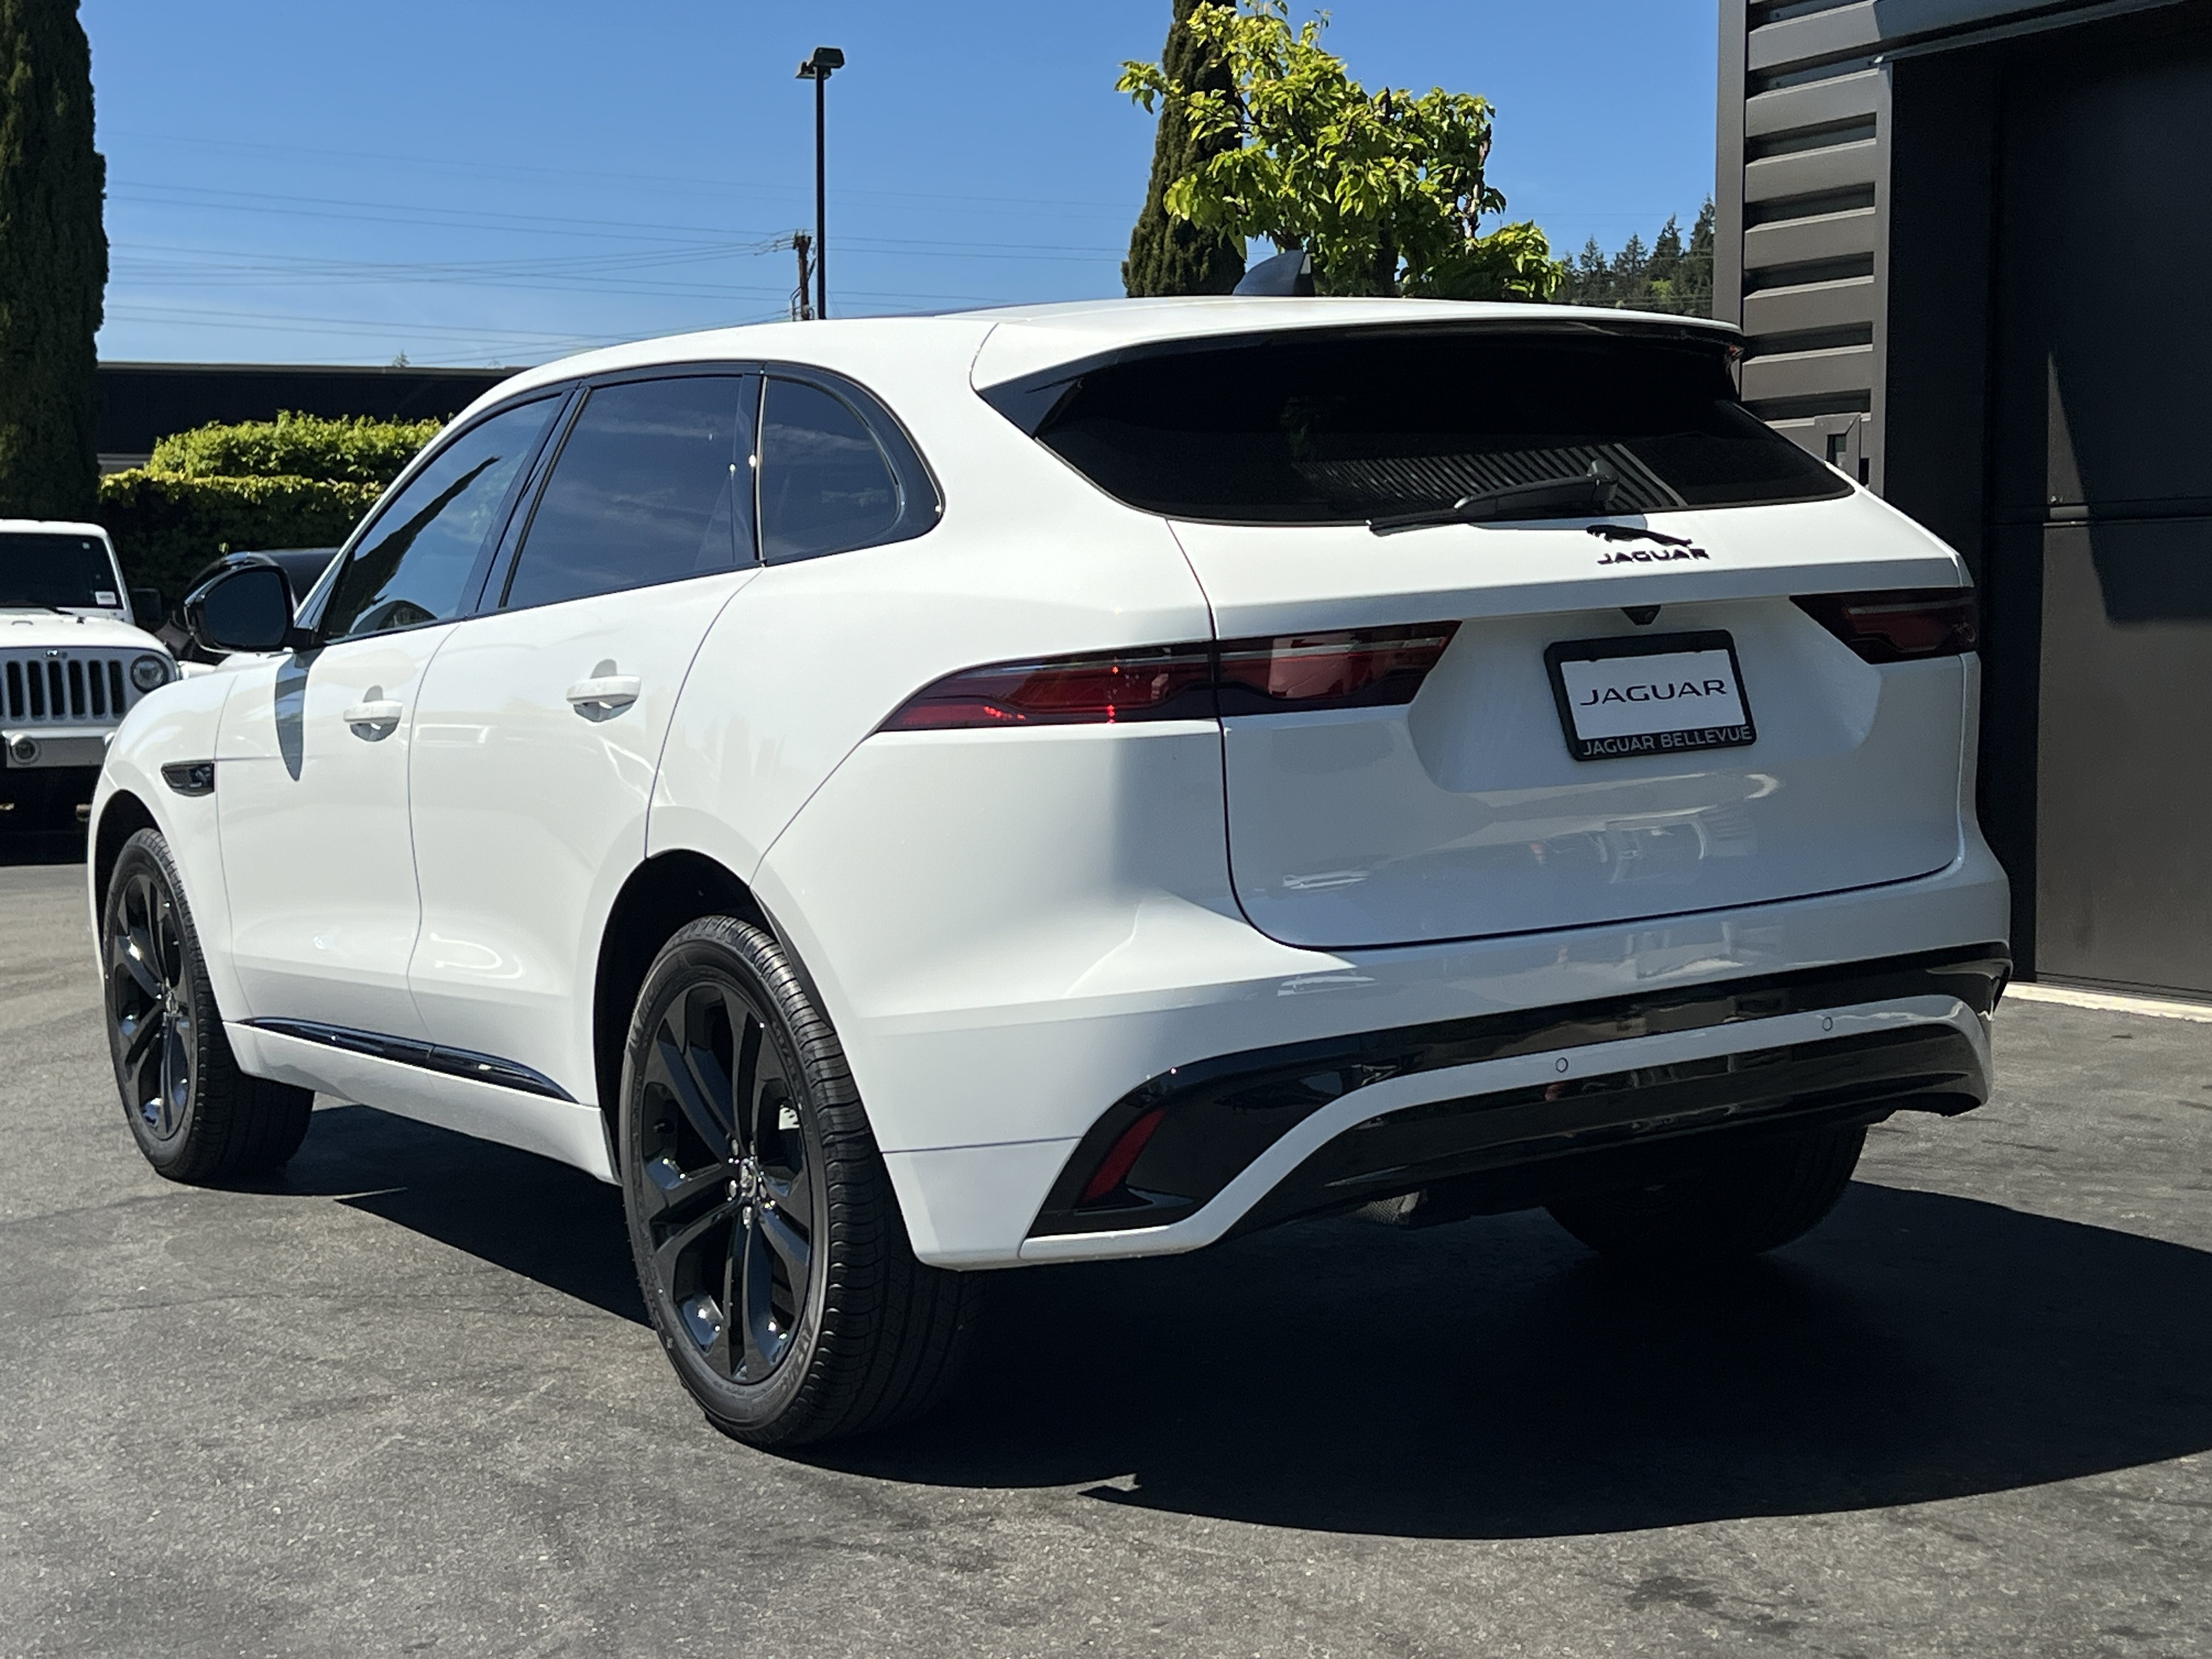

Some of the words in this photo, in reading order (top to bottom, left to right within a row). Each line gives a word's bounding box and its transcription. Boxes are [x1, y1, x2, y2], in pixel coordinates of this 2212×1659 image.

[1596, 549, 1711, 565] JAGUAR
[1579, 679, 1727, 706] JAGUAR
[1583, 736, 1655, 756] JAGUAR
[1660, 726, 1753, 748] BELLEVUE
